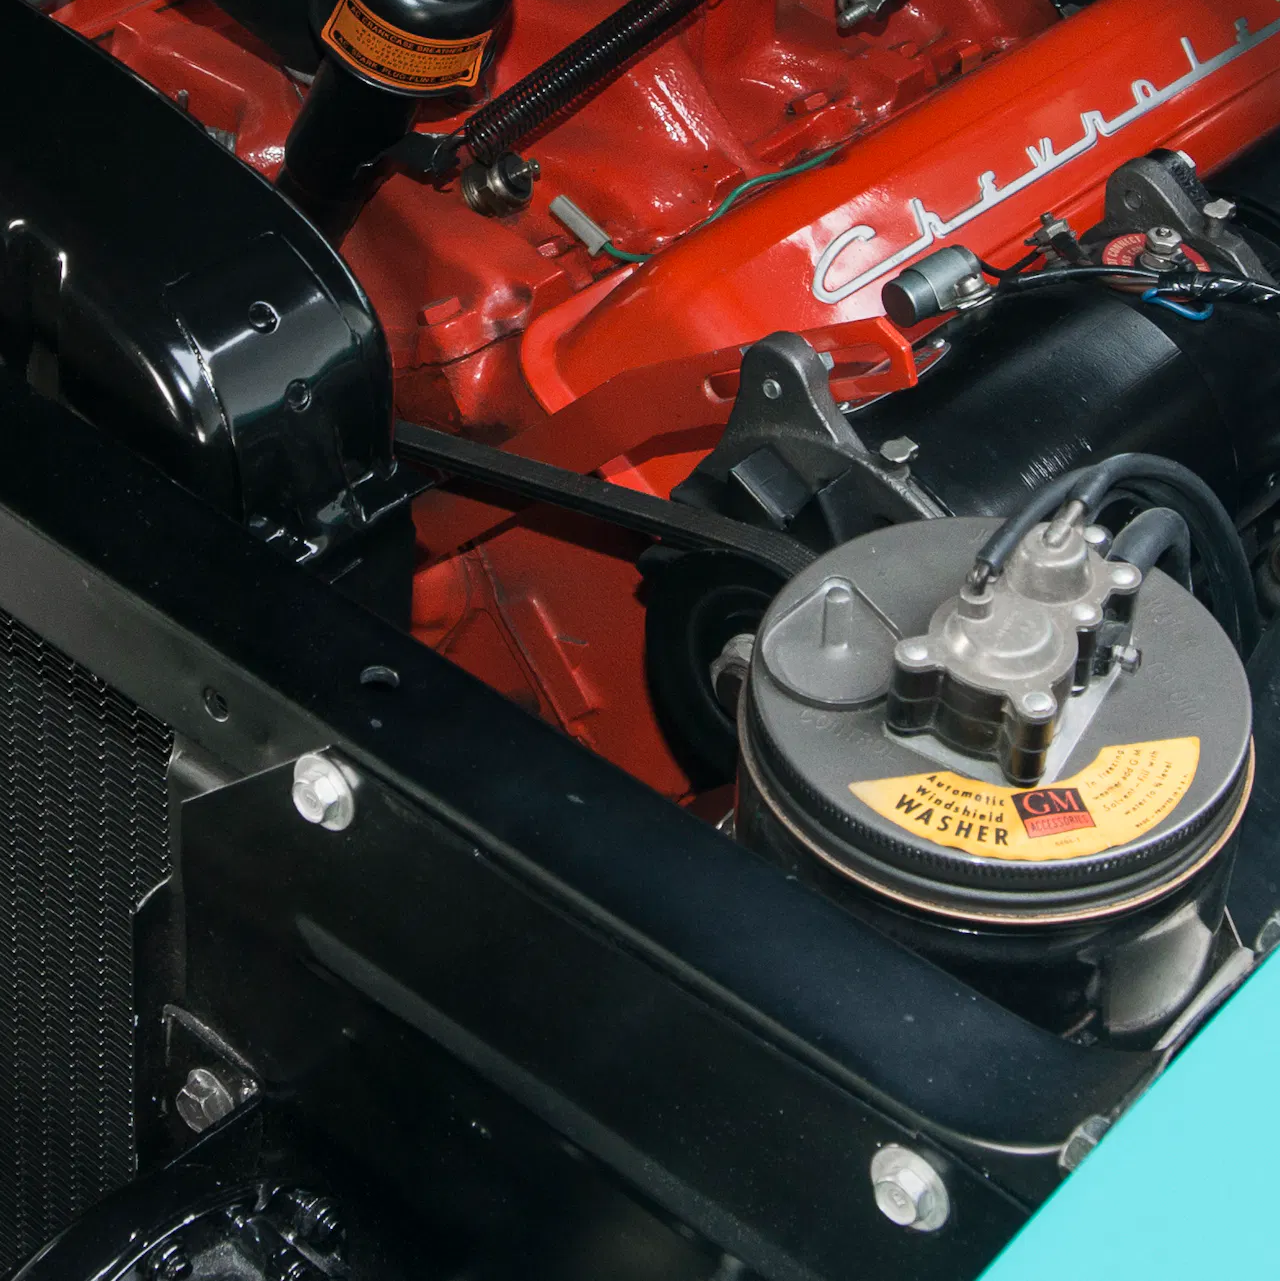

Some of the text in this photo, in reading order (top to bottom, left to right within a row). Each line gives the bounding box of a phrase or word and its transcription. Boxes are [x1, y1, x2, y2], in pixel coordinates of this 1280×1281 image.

[1109, 234, 1142, 258] CONNECT
[1098, 750, 1124, 779] freezing
[1122, 767, 1134, 780] add
[916, 784, 1004, 823] Windshield
[926, 774, 1005, 807] Automatic
[1022, 790, 1080, 815] GM
[1103, 788, 1136, 812] Solvent
[1137, 768, 1150, 782] fill
[1125, 798, 1148, 816] water
[1146, 790, 1157, 799] to
[1156, 761, 1173, 780] level
[895, 793, 1009, 846] WASHER
[1030, 814, 1090, 832] ACCESSORIES
